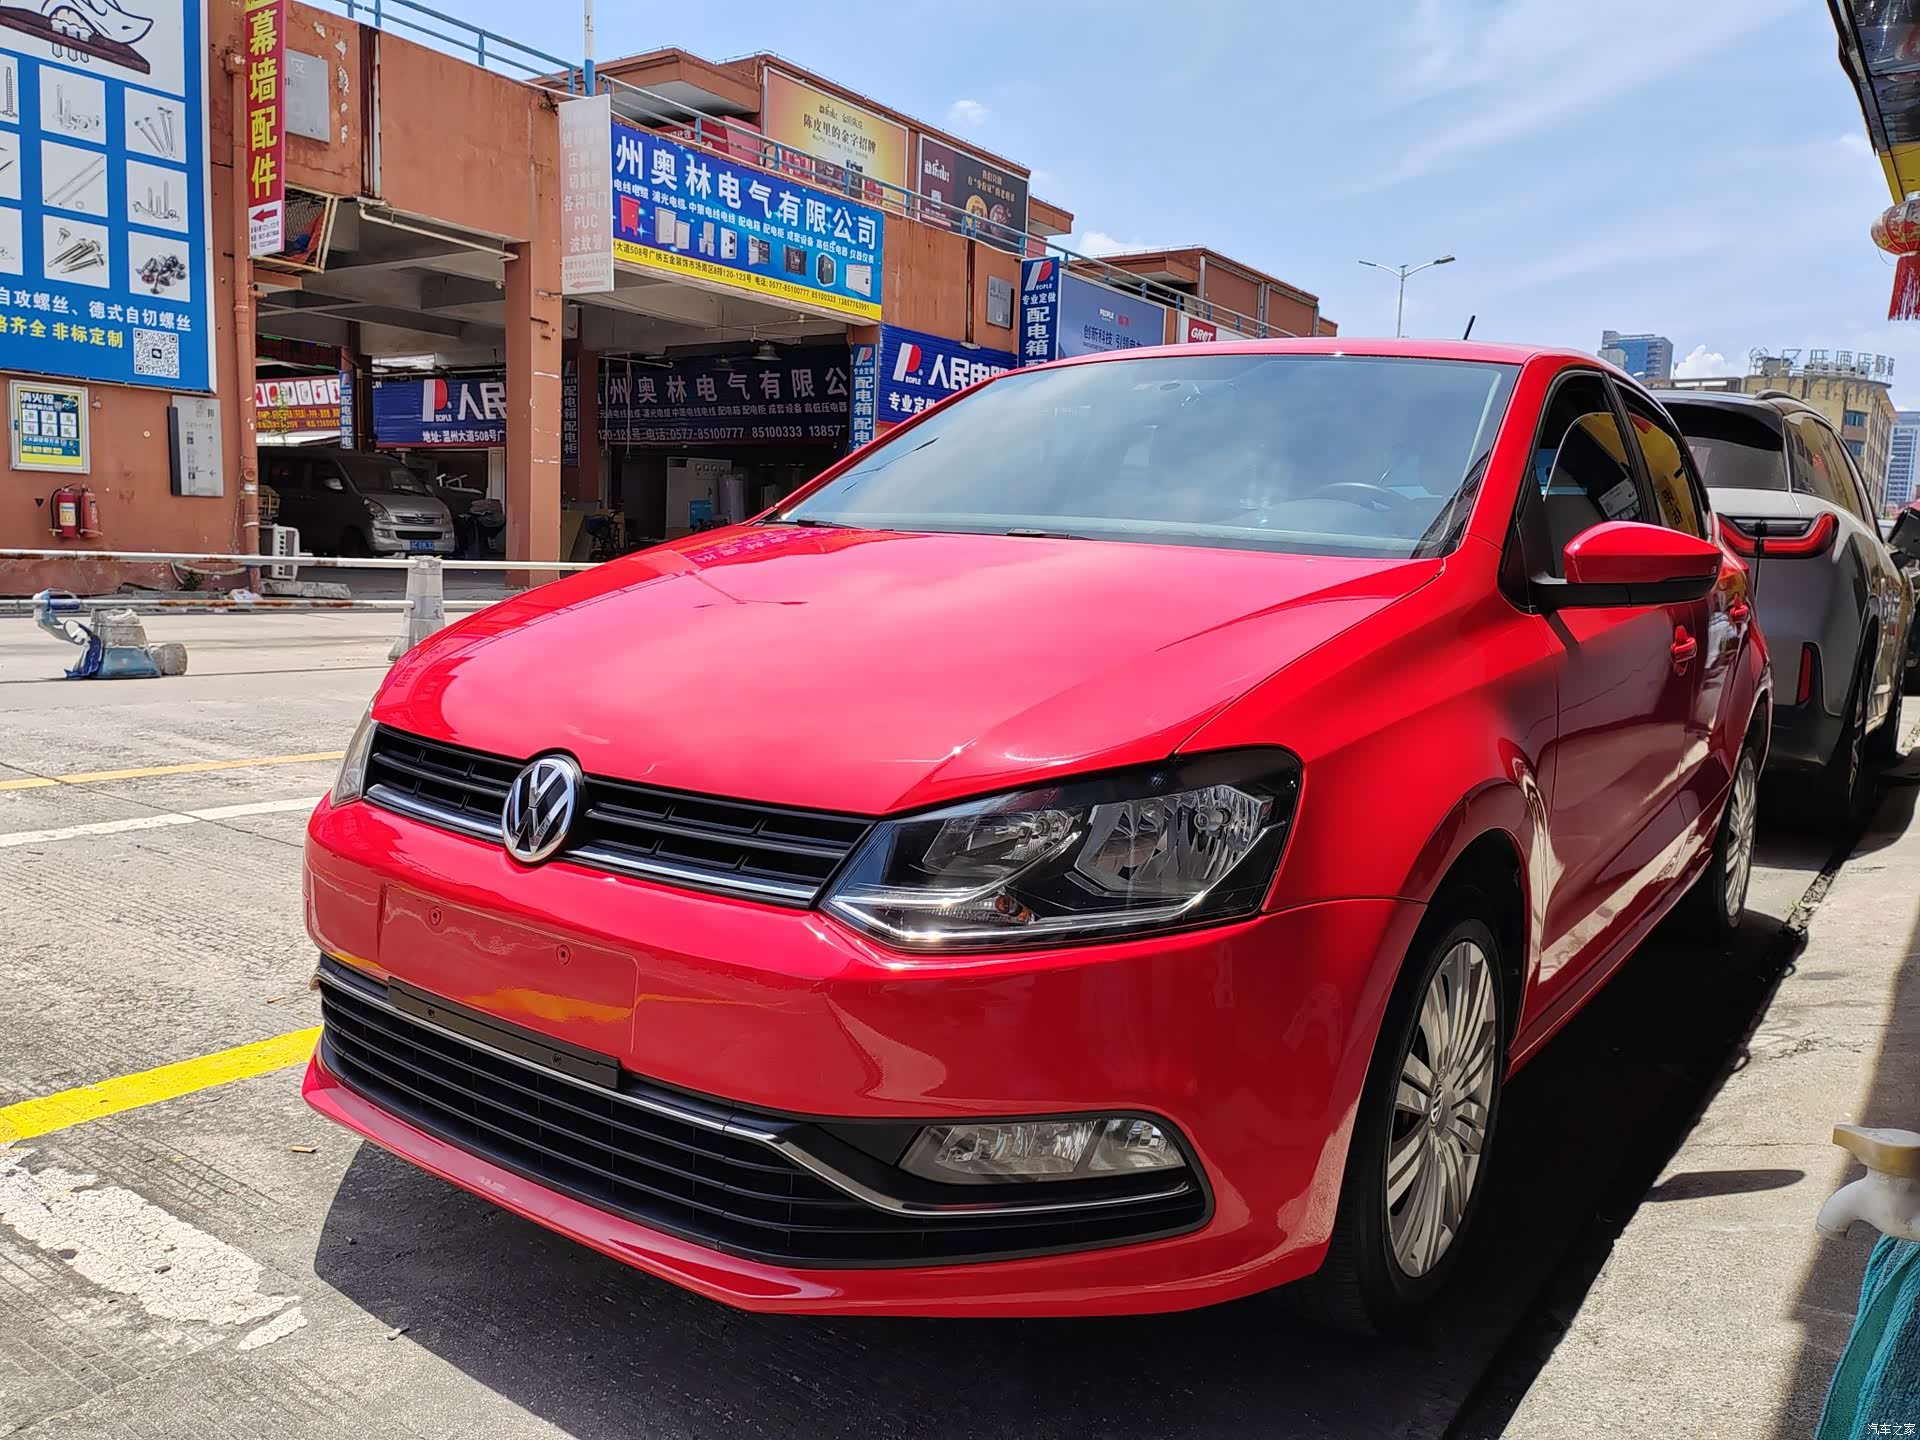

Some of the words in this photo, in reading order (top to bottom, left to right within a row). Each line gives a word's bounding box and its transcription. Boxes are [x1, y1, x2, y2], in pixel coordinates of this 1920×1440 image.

[250, 9, 277, 199] 幕墙配件
[803, 112, 876, 155] 陈皮里的金字招牌
[615, 135, 876, 250] 州奥林电气有限公司
[763, 222, 785, 239] 配电柜
[1022, 292, 1057, 305] 专业定做
[52, 322, 123, 348] 非标定制
[1083, 324, 1113, 345] 创新科技
[598, 366, 848, 405] 州奥林电气有限公
[457, 383, 507, 421] 人民
[768, 403, 802, 414] 成套设备
[804, 401, 848, 413] 高低压电器
[341, 395, 352, 449] 配电箱配电
[752, 425, 802, 438] 85100333
[809, 424, 847, 437] 13857
